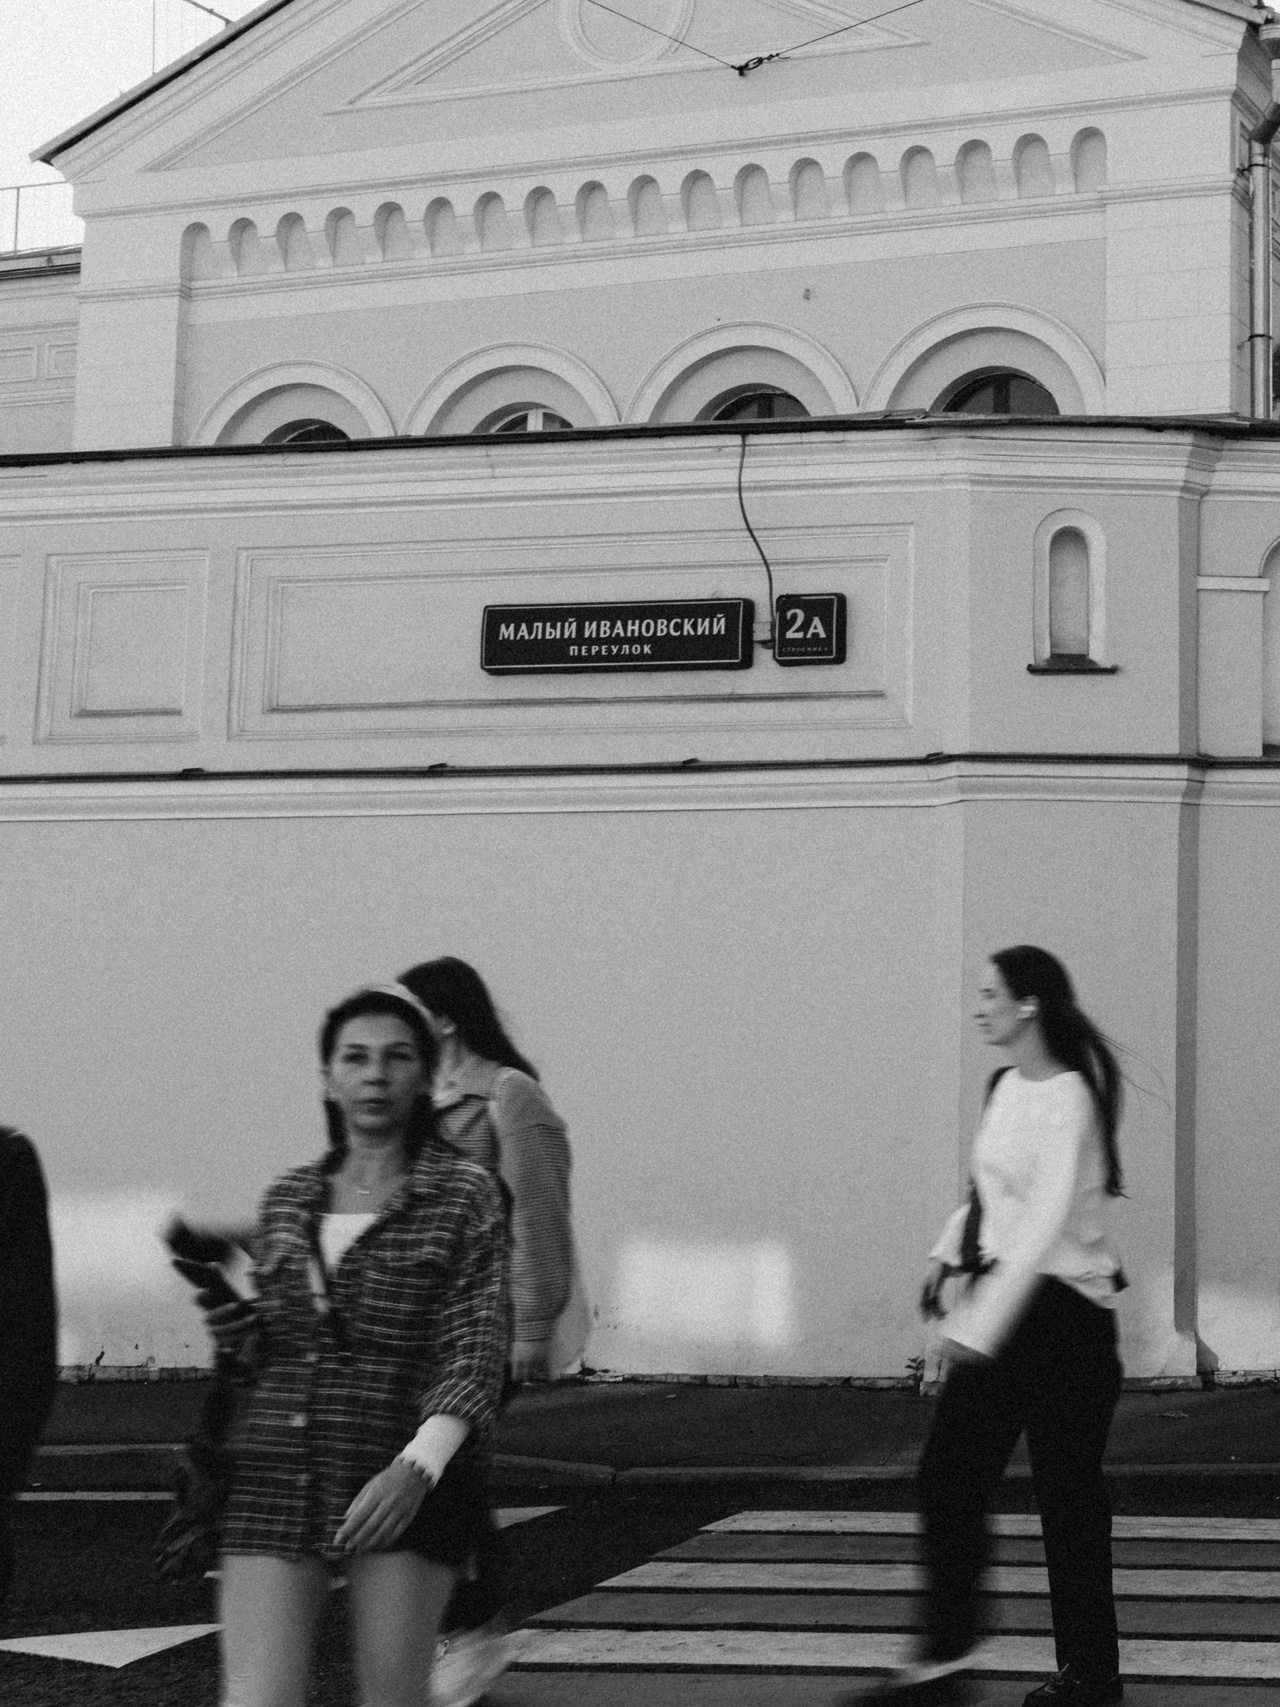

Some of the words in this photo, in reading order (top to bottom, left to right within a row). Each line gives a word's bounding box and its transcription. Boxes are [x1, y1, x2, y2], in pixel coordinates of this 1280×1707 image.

[499, 618, 577, 640] МАЛЫЙ
[584, 613, 726, 639] ИВАНОВСКИЙ
[785, 608, 827, 639] 2А
[569, 644, 652, 656] ПЕРЕУЛОК
